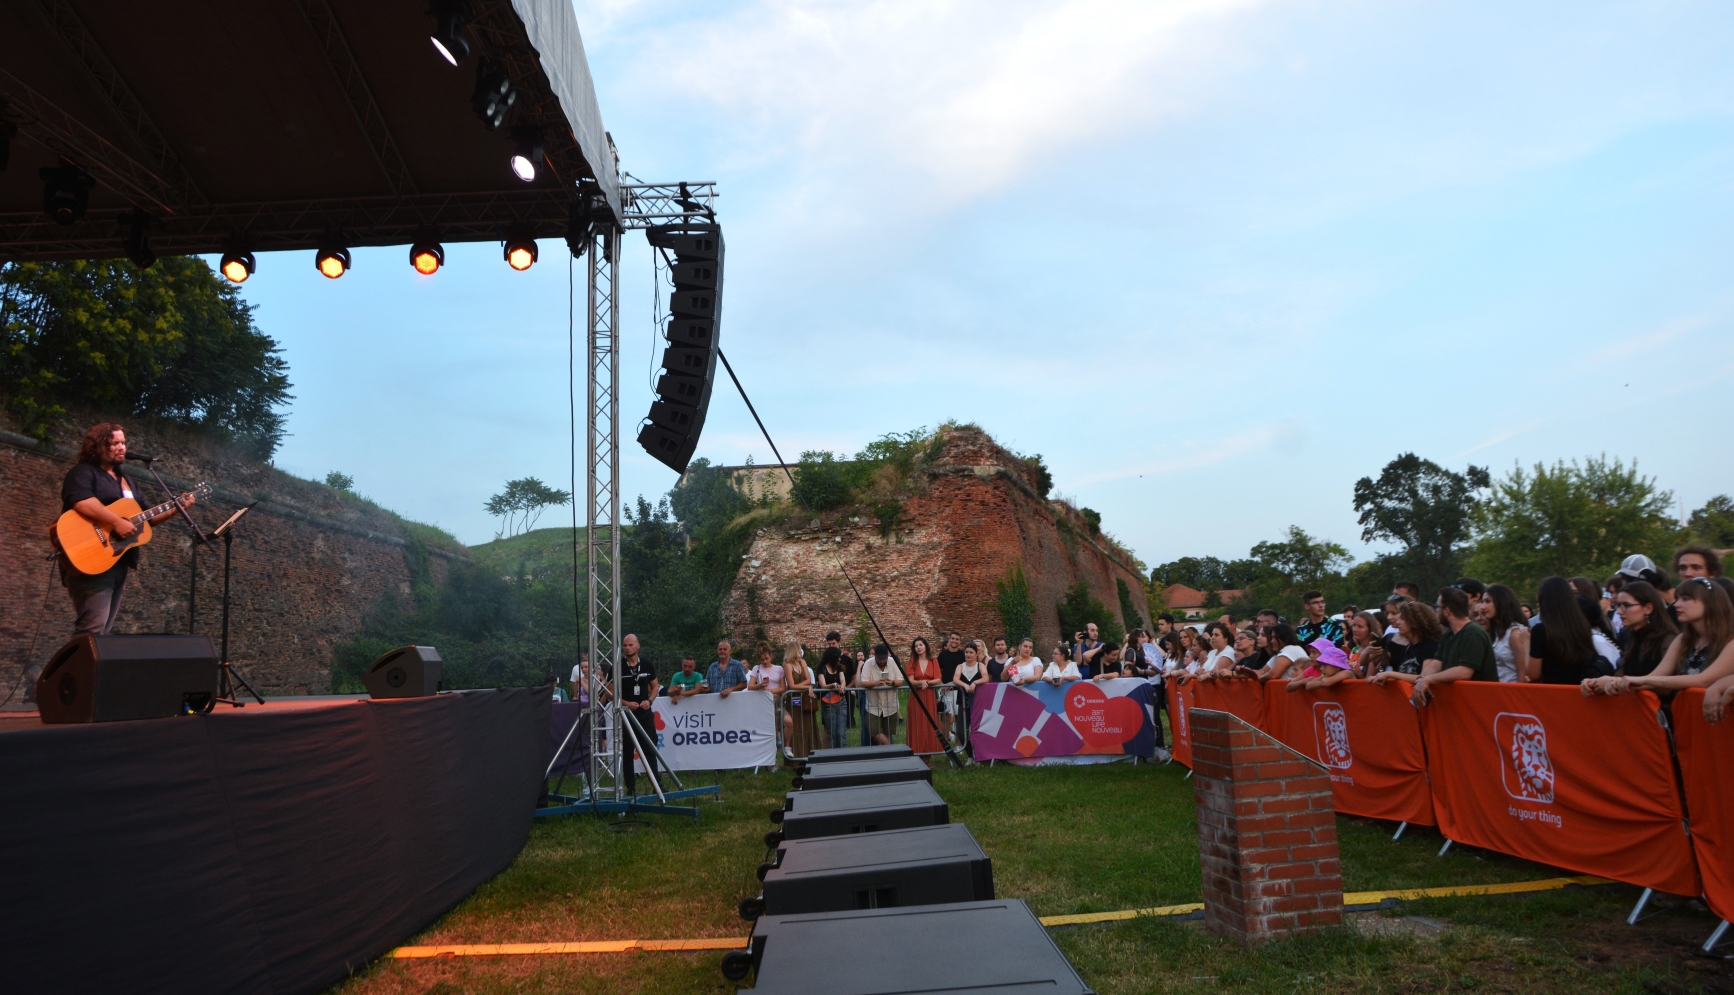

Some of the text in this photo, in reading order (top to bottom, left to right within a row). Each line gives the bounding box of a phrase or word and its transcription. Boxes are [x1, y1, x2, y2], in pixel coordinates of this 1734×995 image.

[1341, 774, 1355, 787] thing
[1508, 804, 1562, 828] do your thing
